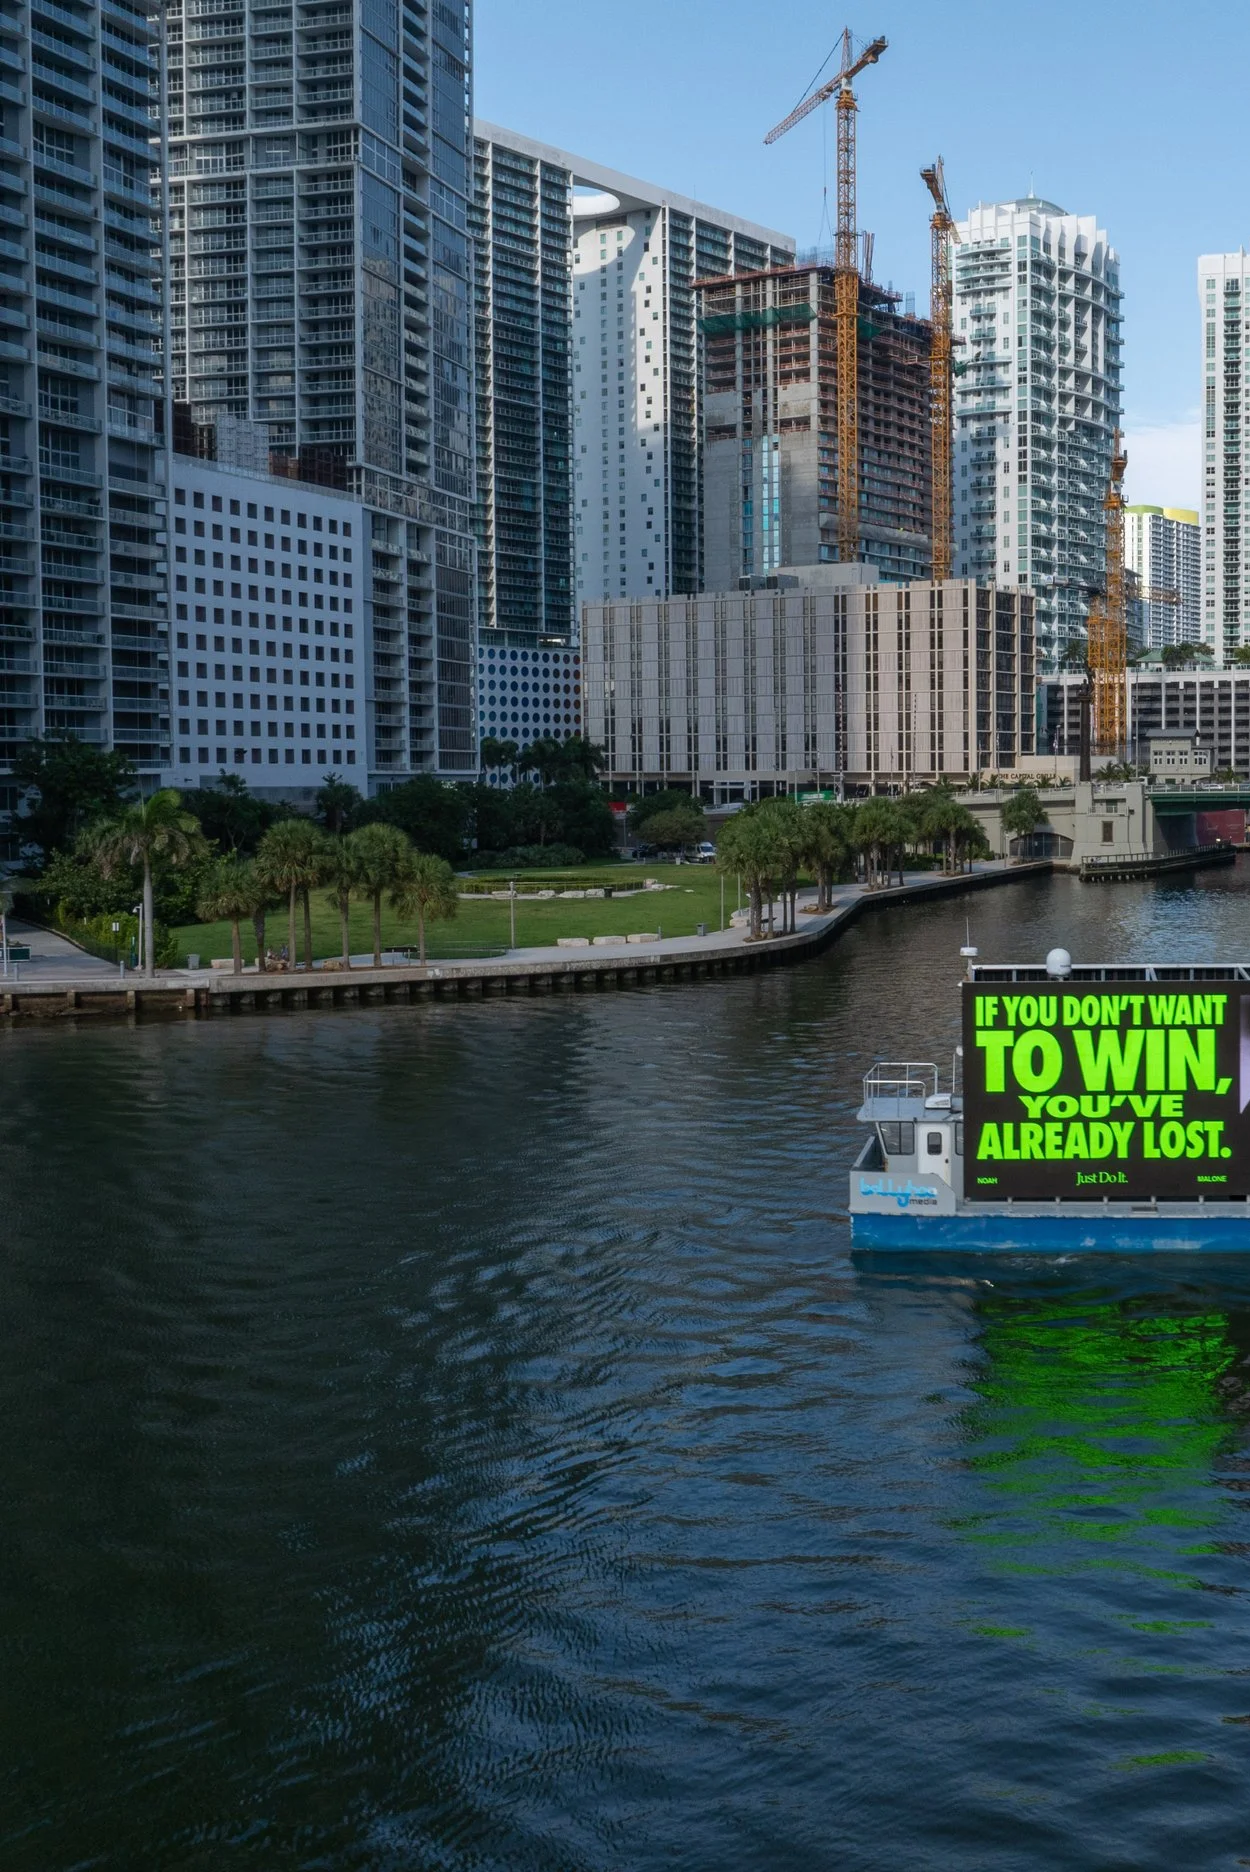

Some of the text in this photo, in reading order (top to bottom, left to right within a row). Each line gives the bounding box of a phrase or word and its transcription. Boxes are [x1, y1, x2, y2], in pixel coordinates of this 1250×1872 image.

[975, 994, 1228, 1027] IF YOU DON'T WANT
[975, 1028, 1233, 1095] TO WIN,
[1018, 1094, 1184, 1119] YOU'VE
[976, 1120, 1233, 1160] ALREADY LOST.
[976, 1176, 998, 1185] NOAH
[1075, 1171, 1129, 1186] Just Do It.
[1196, 1175, 1228, 1183] MALONE
[910, 1197, 938, 1206] media
